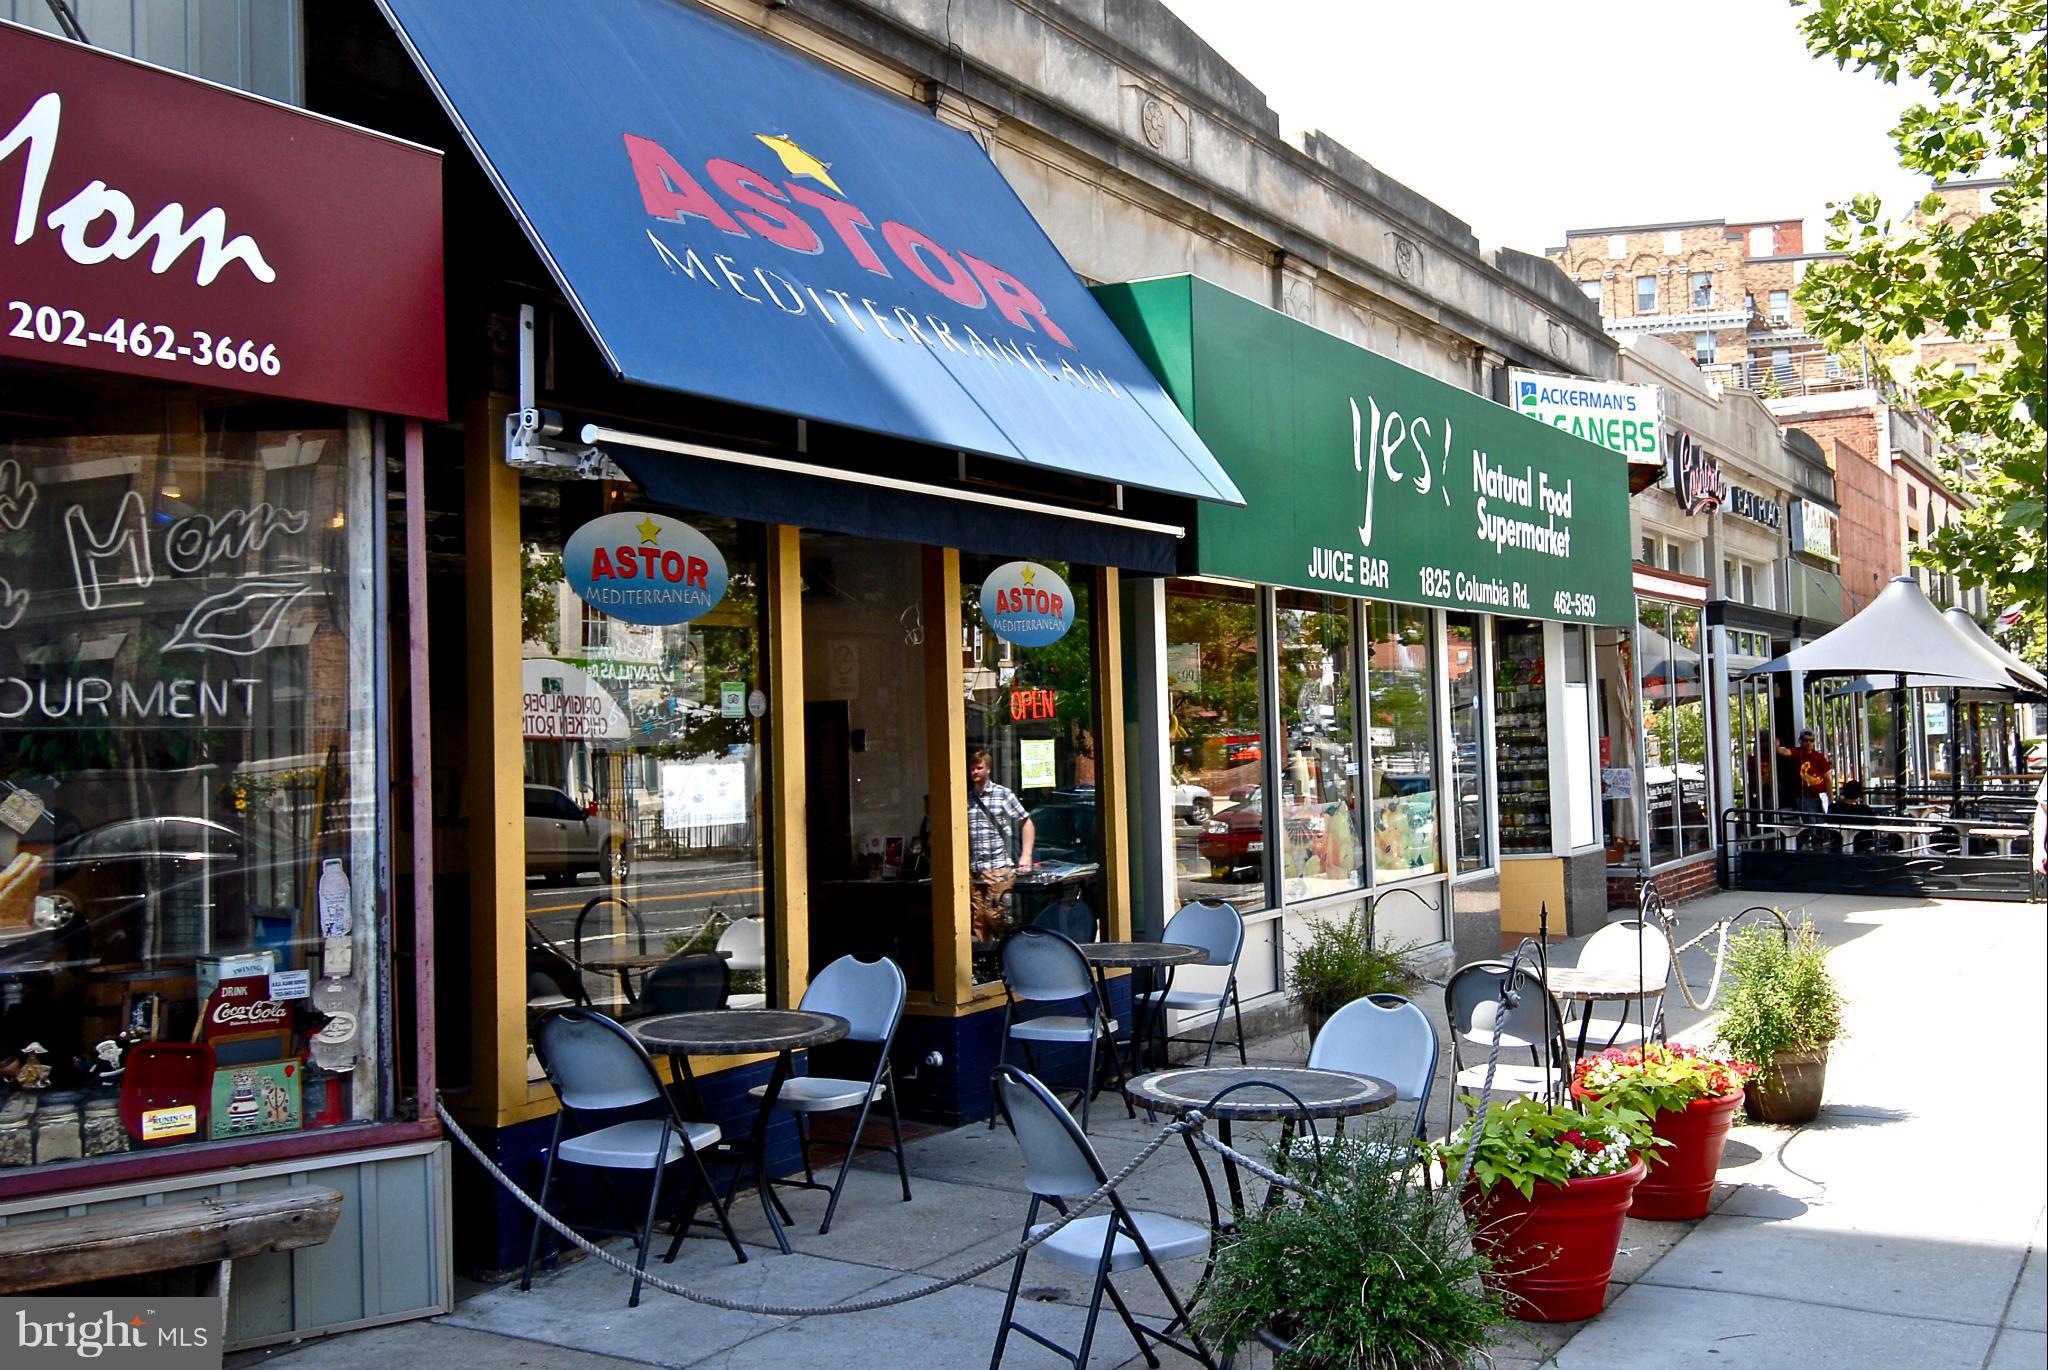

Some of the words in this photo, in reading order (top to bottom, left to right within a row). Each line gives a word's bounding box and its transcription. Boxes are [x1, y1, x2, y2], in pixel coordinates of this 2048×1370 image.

[621, 131, 1078, 351] ASTOR
[646, 229, 1121, 400] MEDITERRANEAN
[8, 301, 281, 376] 202-462-3666
[1540, 387, 1636, 412] ACKERMAN'S
[1525, 412, 1656, 453] ANERS
[1472, 449, 1532, 508] Natural
[1539, 471, 1572, 519] Food
[1476, 496, 1571, 559] Supermarket
[65, 491, 310, 610] Mom
[591, 545, 709, 591] ASTOR
[1308, 546, 1354, 584] JUICE
[1359, 558, 1389, 589] BAR
[586, 586, 711, 607] MEDITERRANEAN
[995, 587, 1064, 619] ASTOR
[1419, 566, 1451, 600] 1825
[1455, 571, 1510, 609] Columbia
[1512, 581, 1531, 610] Rd.
[1553, 590, 1596, 617] 462-5150
[993, 618, 1066, 632] MEDITERRANEAN
[1010, 688, 1055, 721] OPEN
[213, 1000, 287, 1023] Coca-Cola
[221, 986, 248, 998] DRINK
